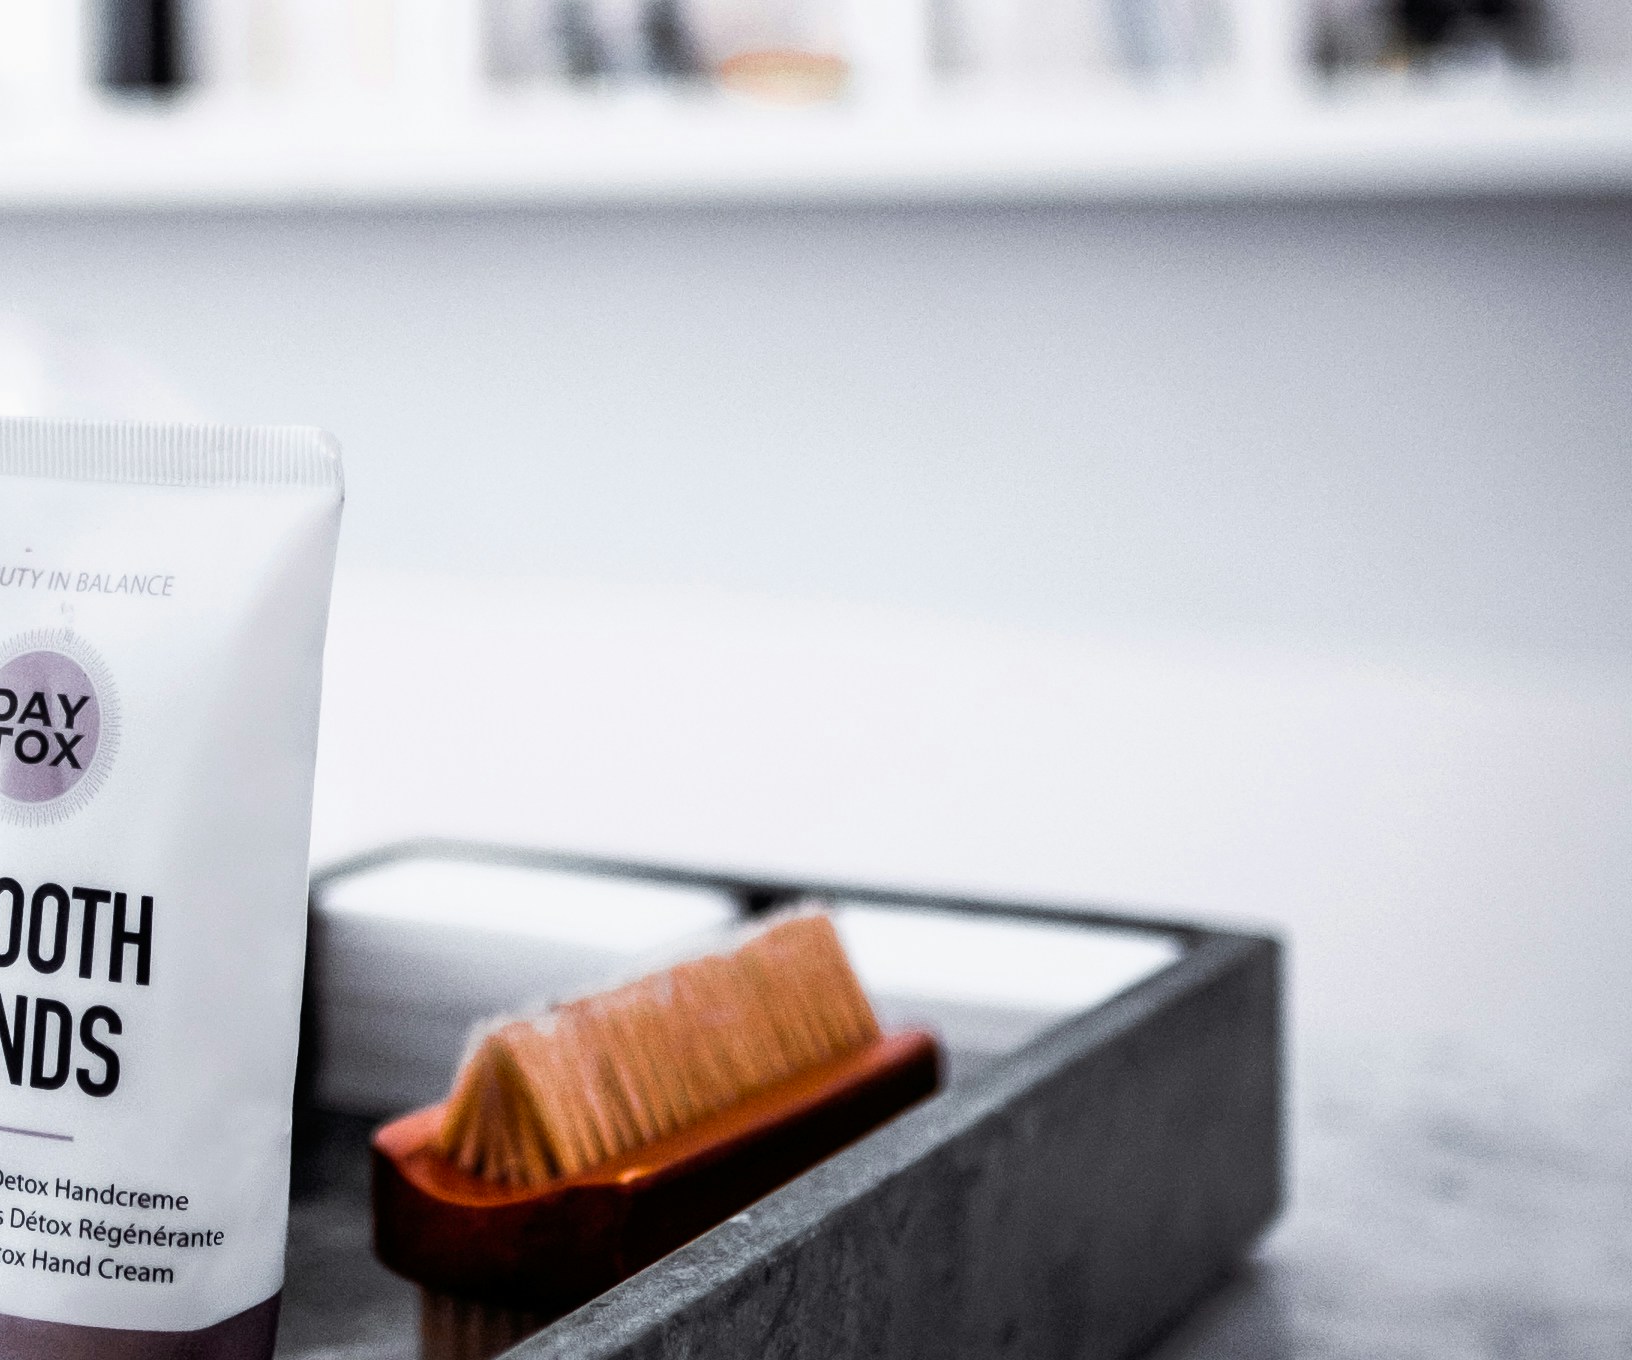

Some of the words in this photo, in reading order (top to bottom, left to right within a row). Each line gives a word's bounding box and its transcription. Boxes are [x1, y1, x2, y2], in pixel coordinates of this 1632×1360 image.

[48, 571, 71, 592] IN
[76, 572, 176, 598] BALANCE
[55, 1178, 190, 1211] Handcreme
[10, 1207, 72, 1238] Détox
[79, 1218, 225, 1249] Régénérante
[32, 1248, 92, 1277] Hand
[98, 1258, 174, 1284] Cream
